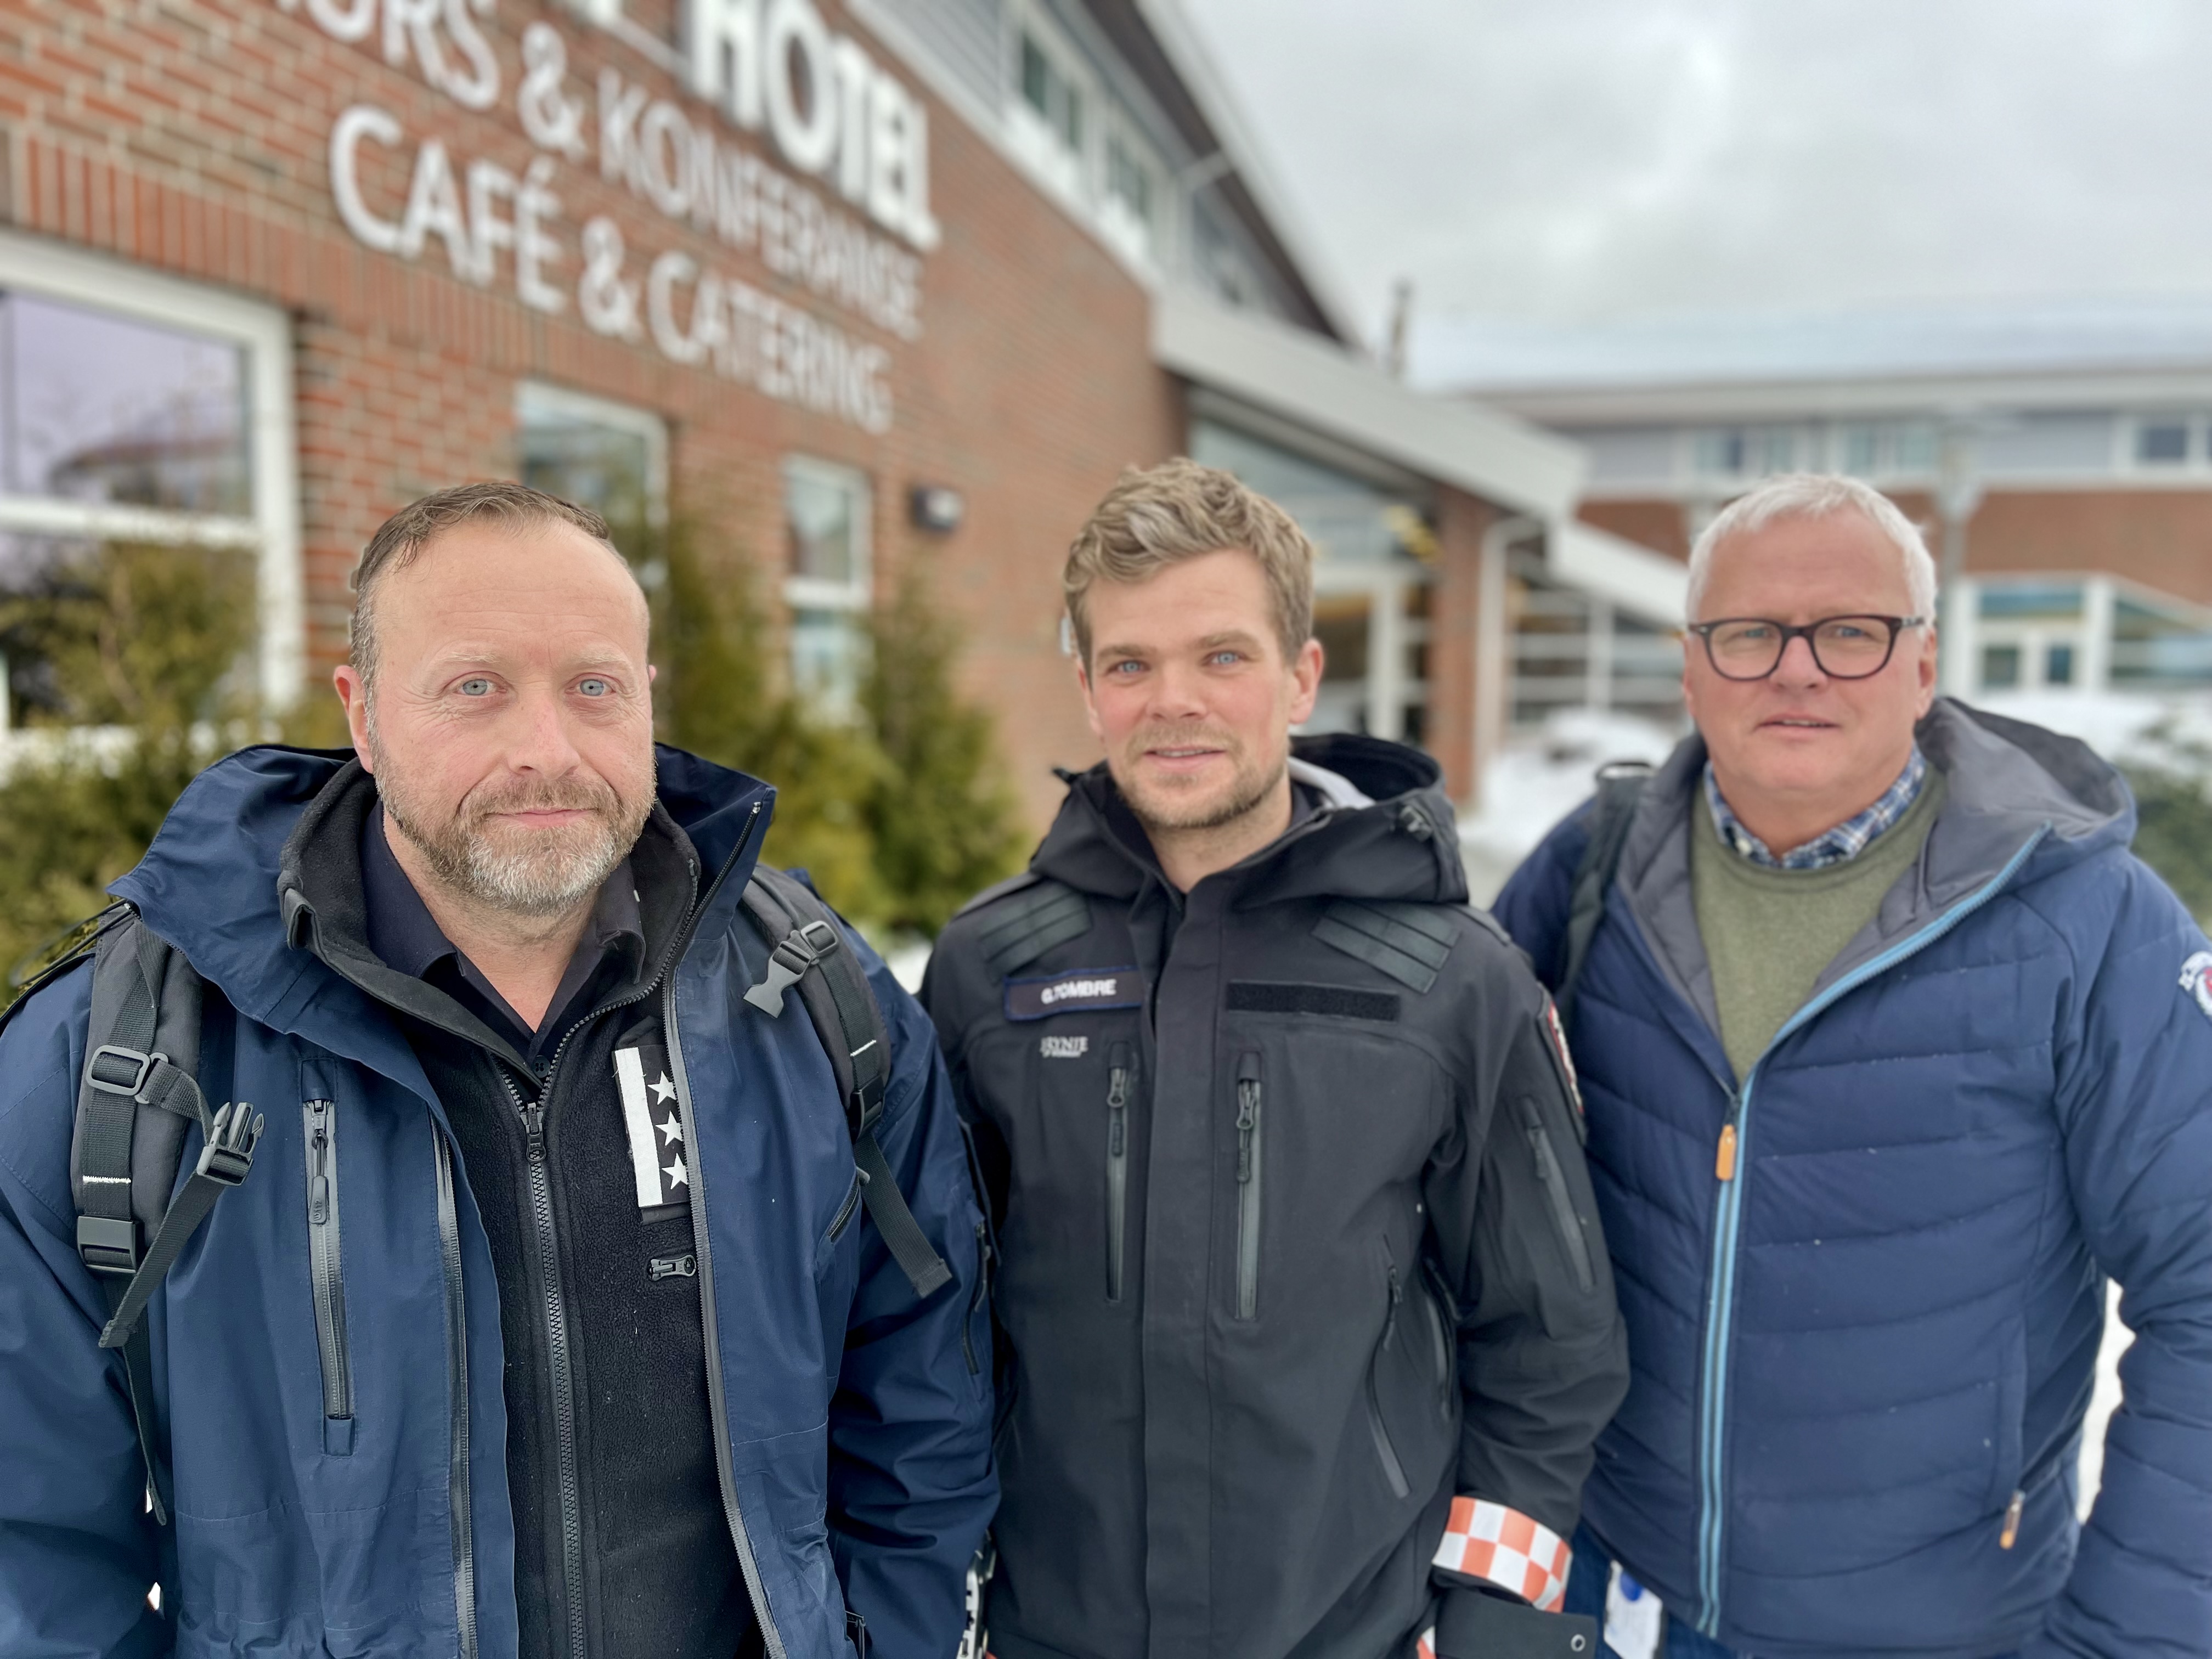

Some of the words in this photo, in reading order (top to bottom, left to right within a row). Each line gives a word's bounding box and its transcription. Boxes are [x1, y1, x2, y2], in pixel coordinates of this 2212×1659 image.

[517, 21, 586, 161] &
[689, 0, 939, 251] HOTEL
[331, 105, 565, 313] CAFÉ
[578, 217, 641, 341] &
[647, 251, 891, 433] CATERING
